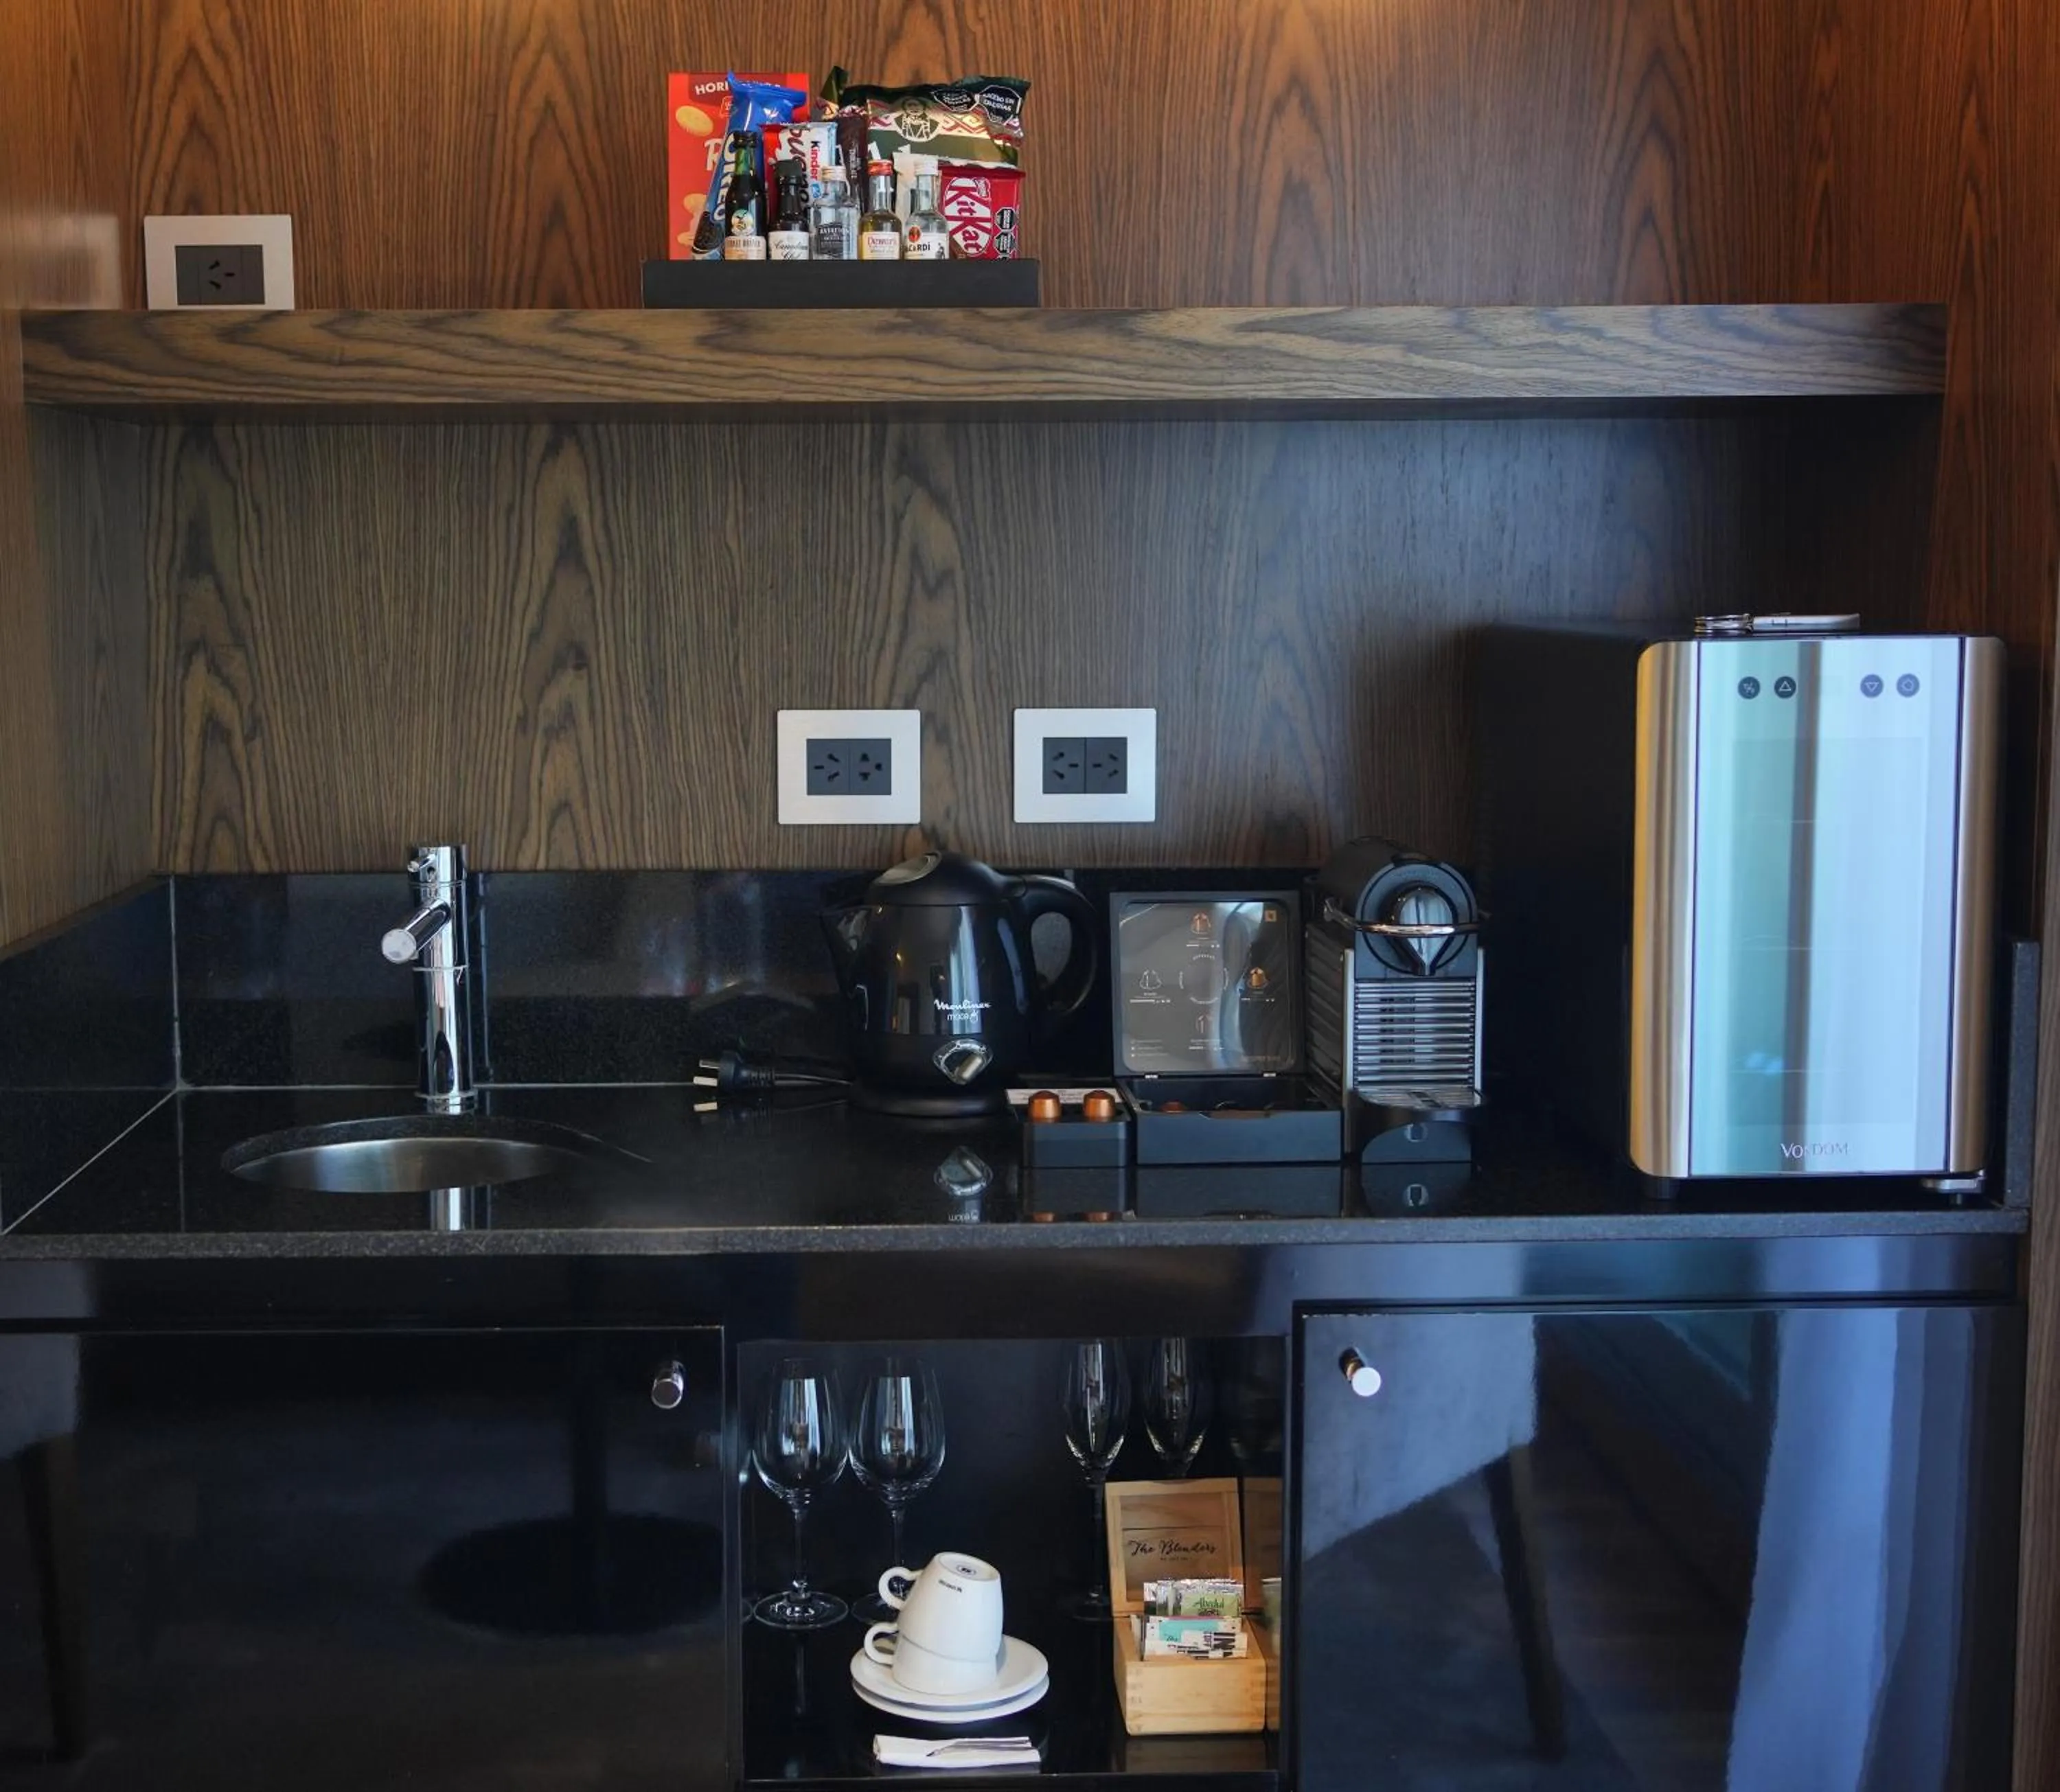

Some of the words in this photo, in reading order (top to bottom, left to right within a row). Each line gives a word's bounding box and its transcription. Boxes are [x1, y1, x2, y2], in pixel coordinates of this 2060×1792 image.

[810, 141, 822, 181] Kinder
[1128, 1540, 1154, 1556] The
[1159, 1539, 1217, 1555] Blenders
